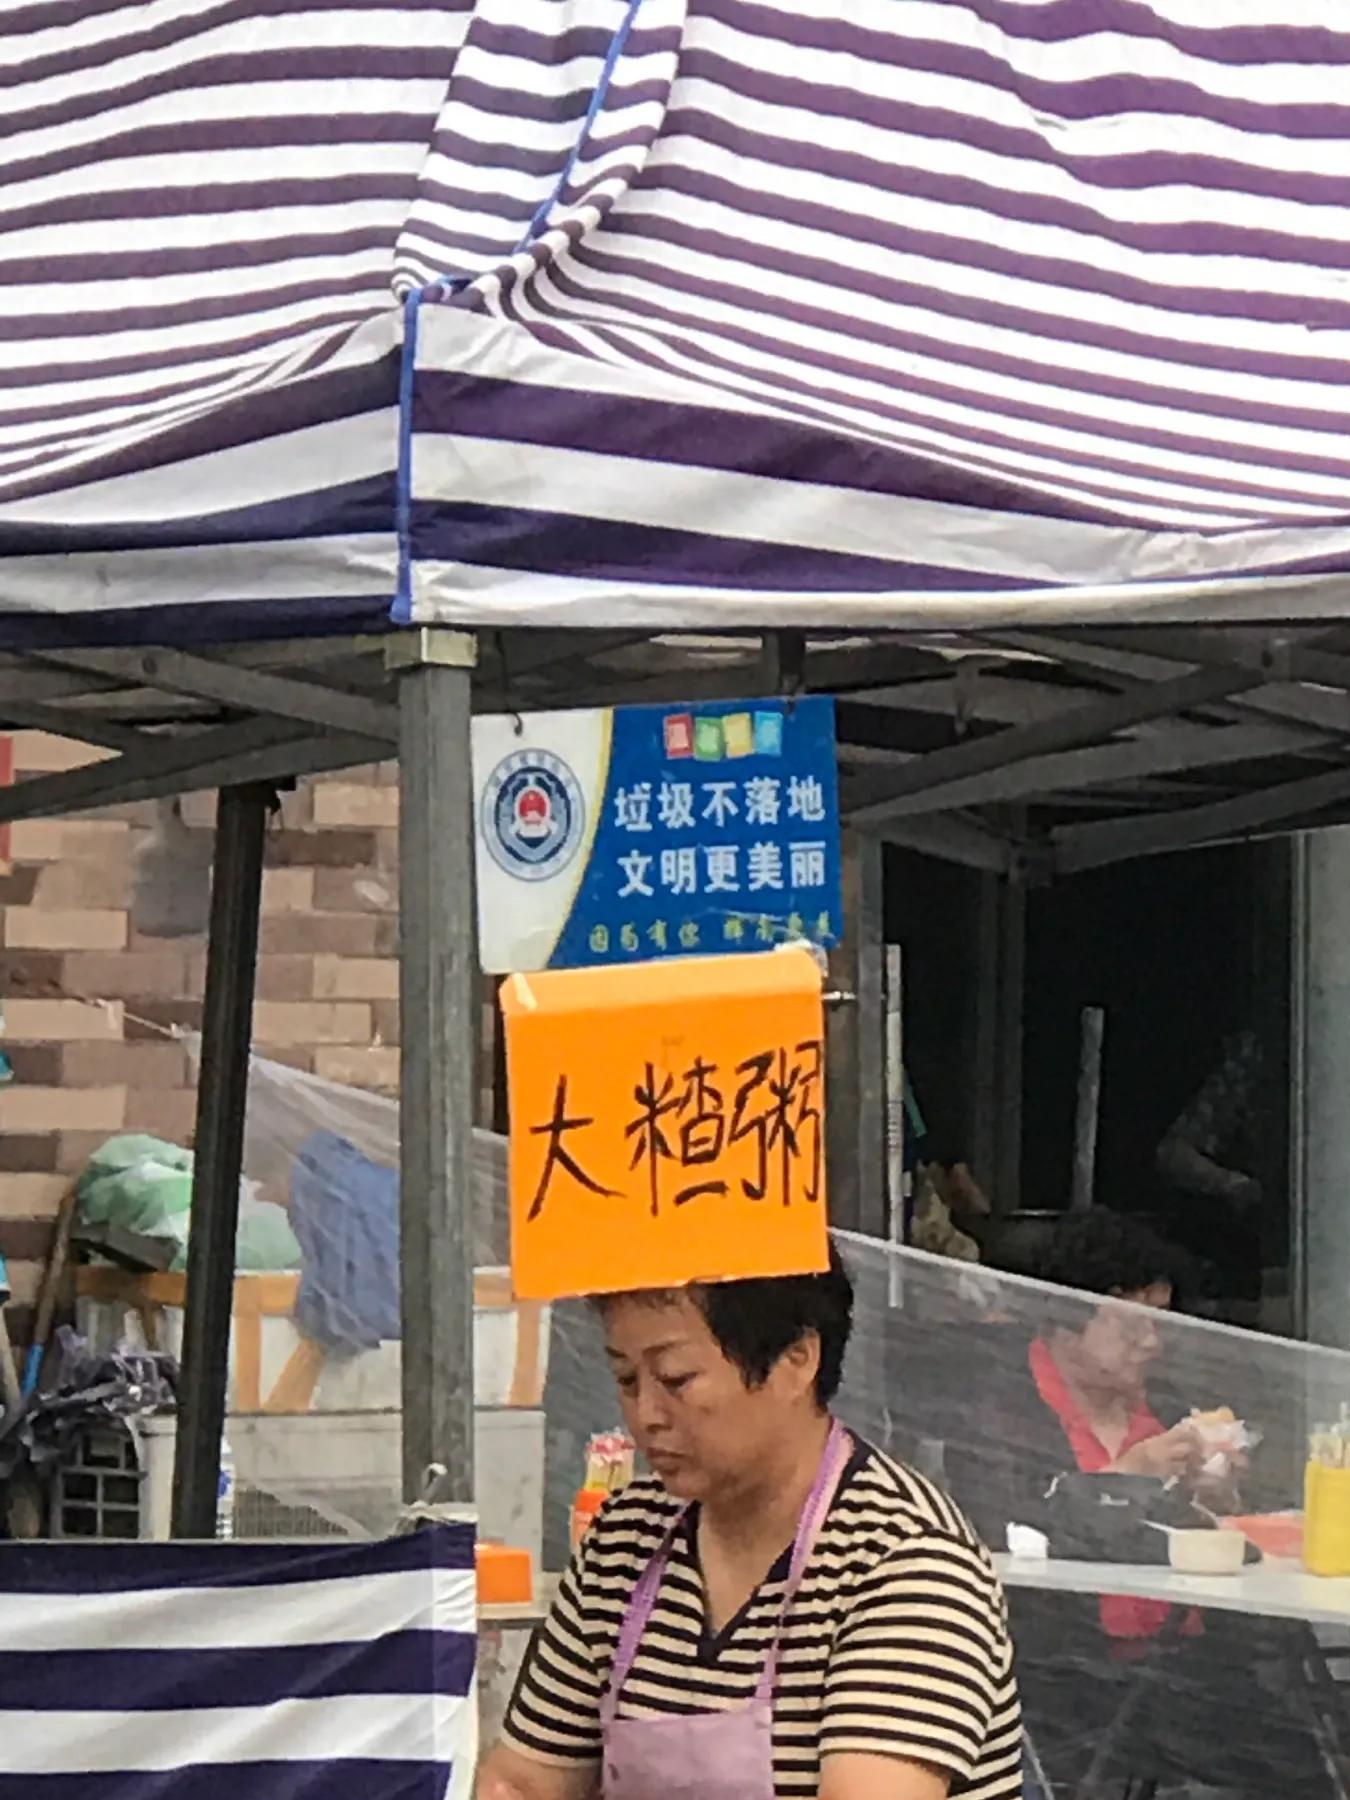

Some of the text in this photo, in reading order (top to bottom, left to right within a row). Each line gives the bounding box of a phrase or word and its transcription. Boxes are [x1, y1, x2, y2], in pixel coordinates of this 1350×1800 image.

[613, 776, 825, 832] 垃圾不落地
[617, 841, 826, 898] 文明更美丽
